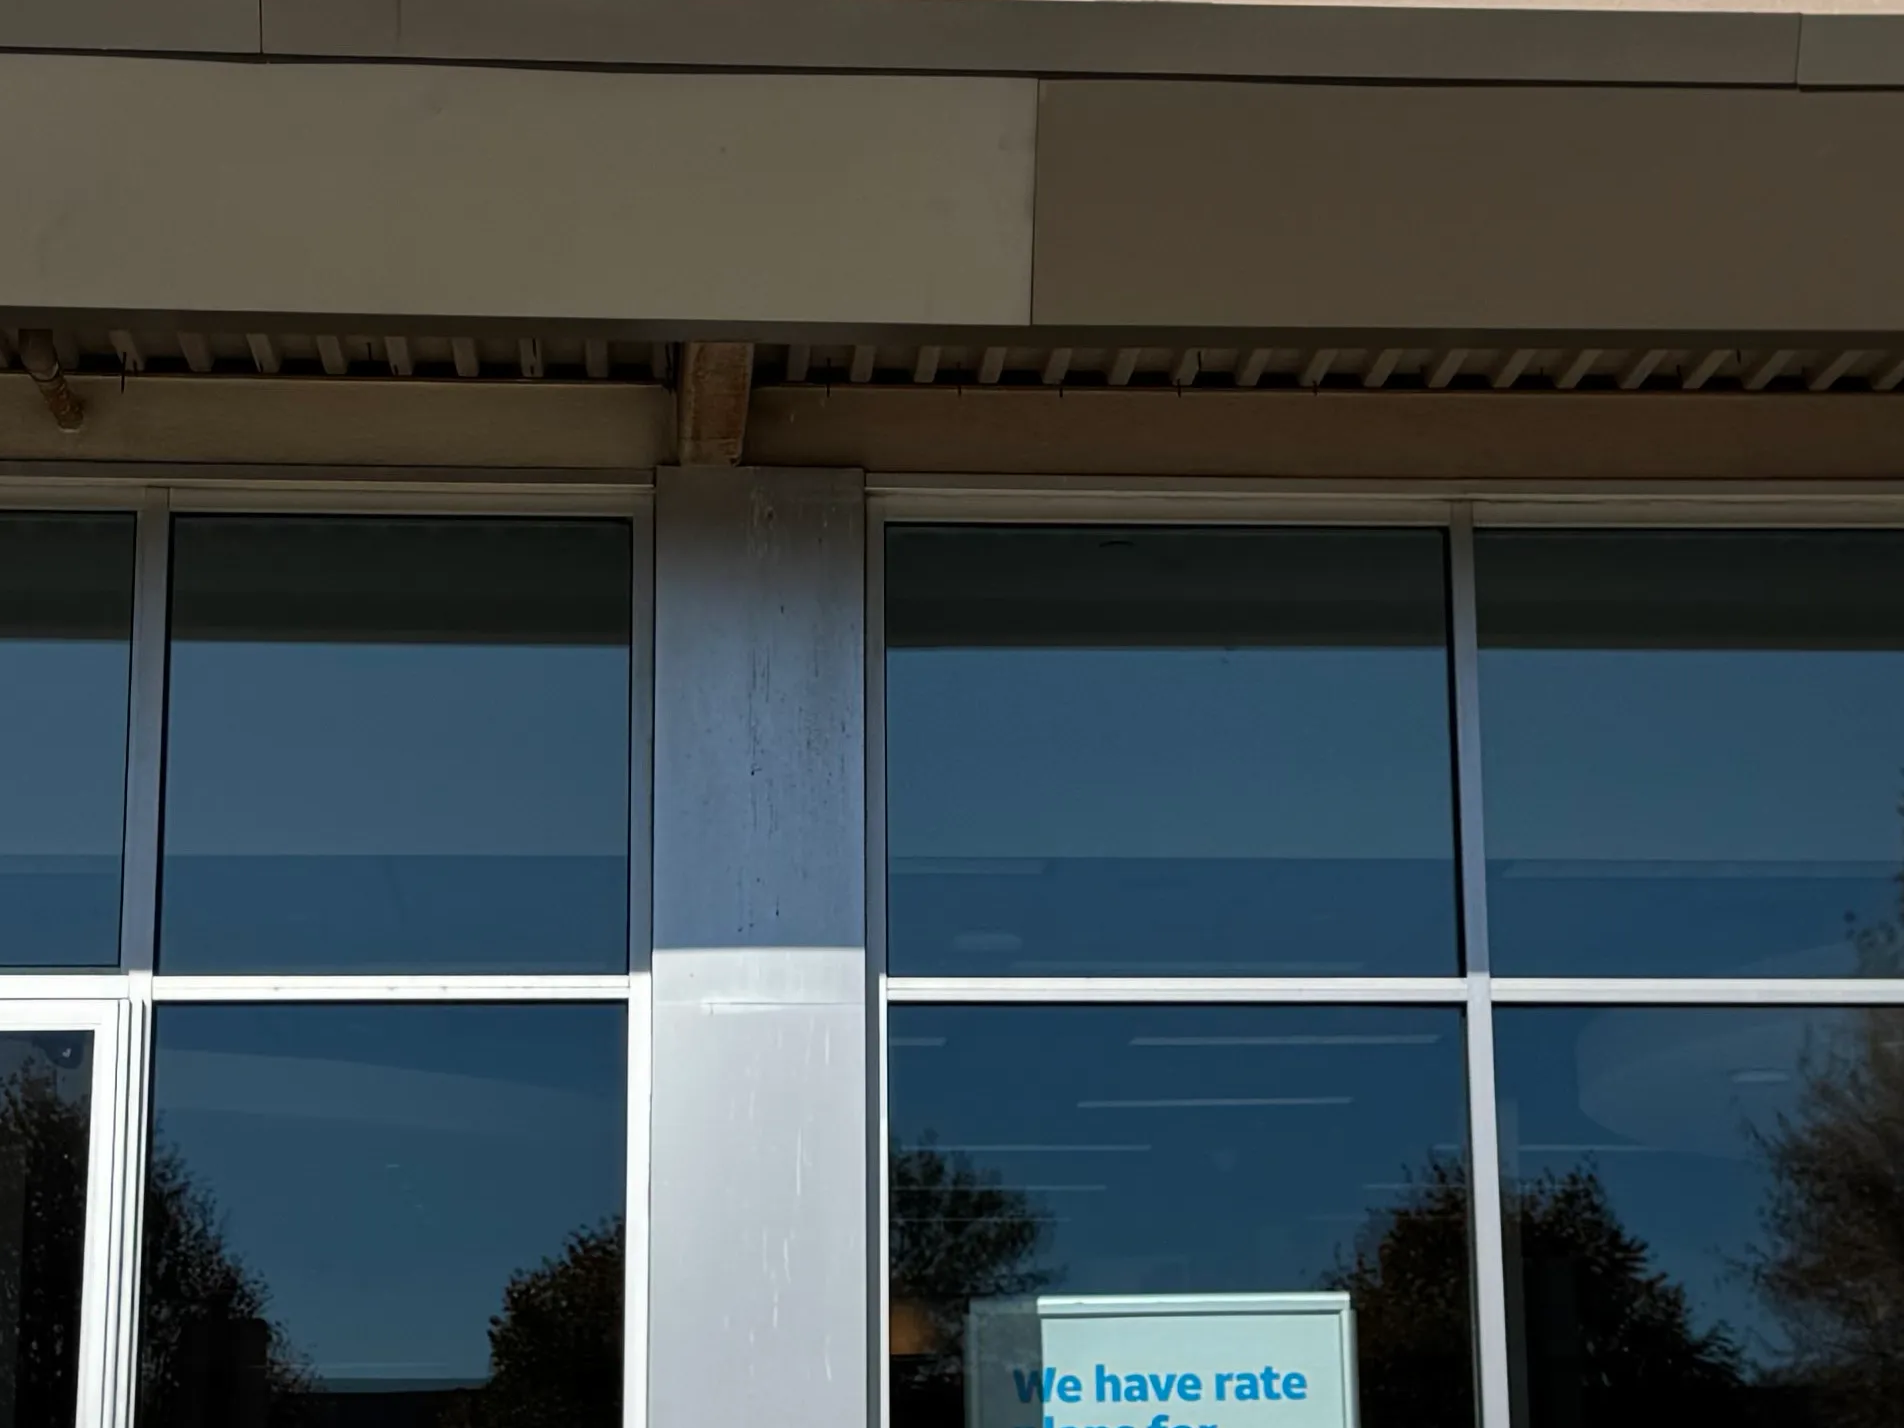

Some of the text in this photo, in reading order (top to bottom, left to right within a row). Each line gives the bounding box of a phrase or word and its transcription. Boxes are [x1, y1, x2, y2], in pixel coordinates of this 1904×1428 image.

[1014, 1364, 1307, 1403] We have rate
